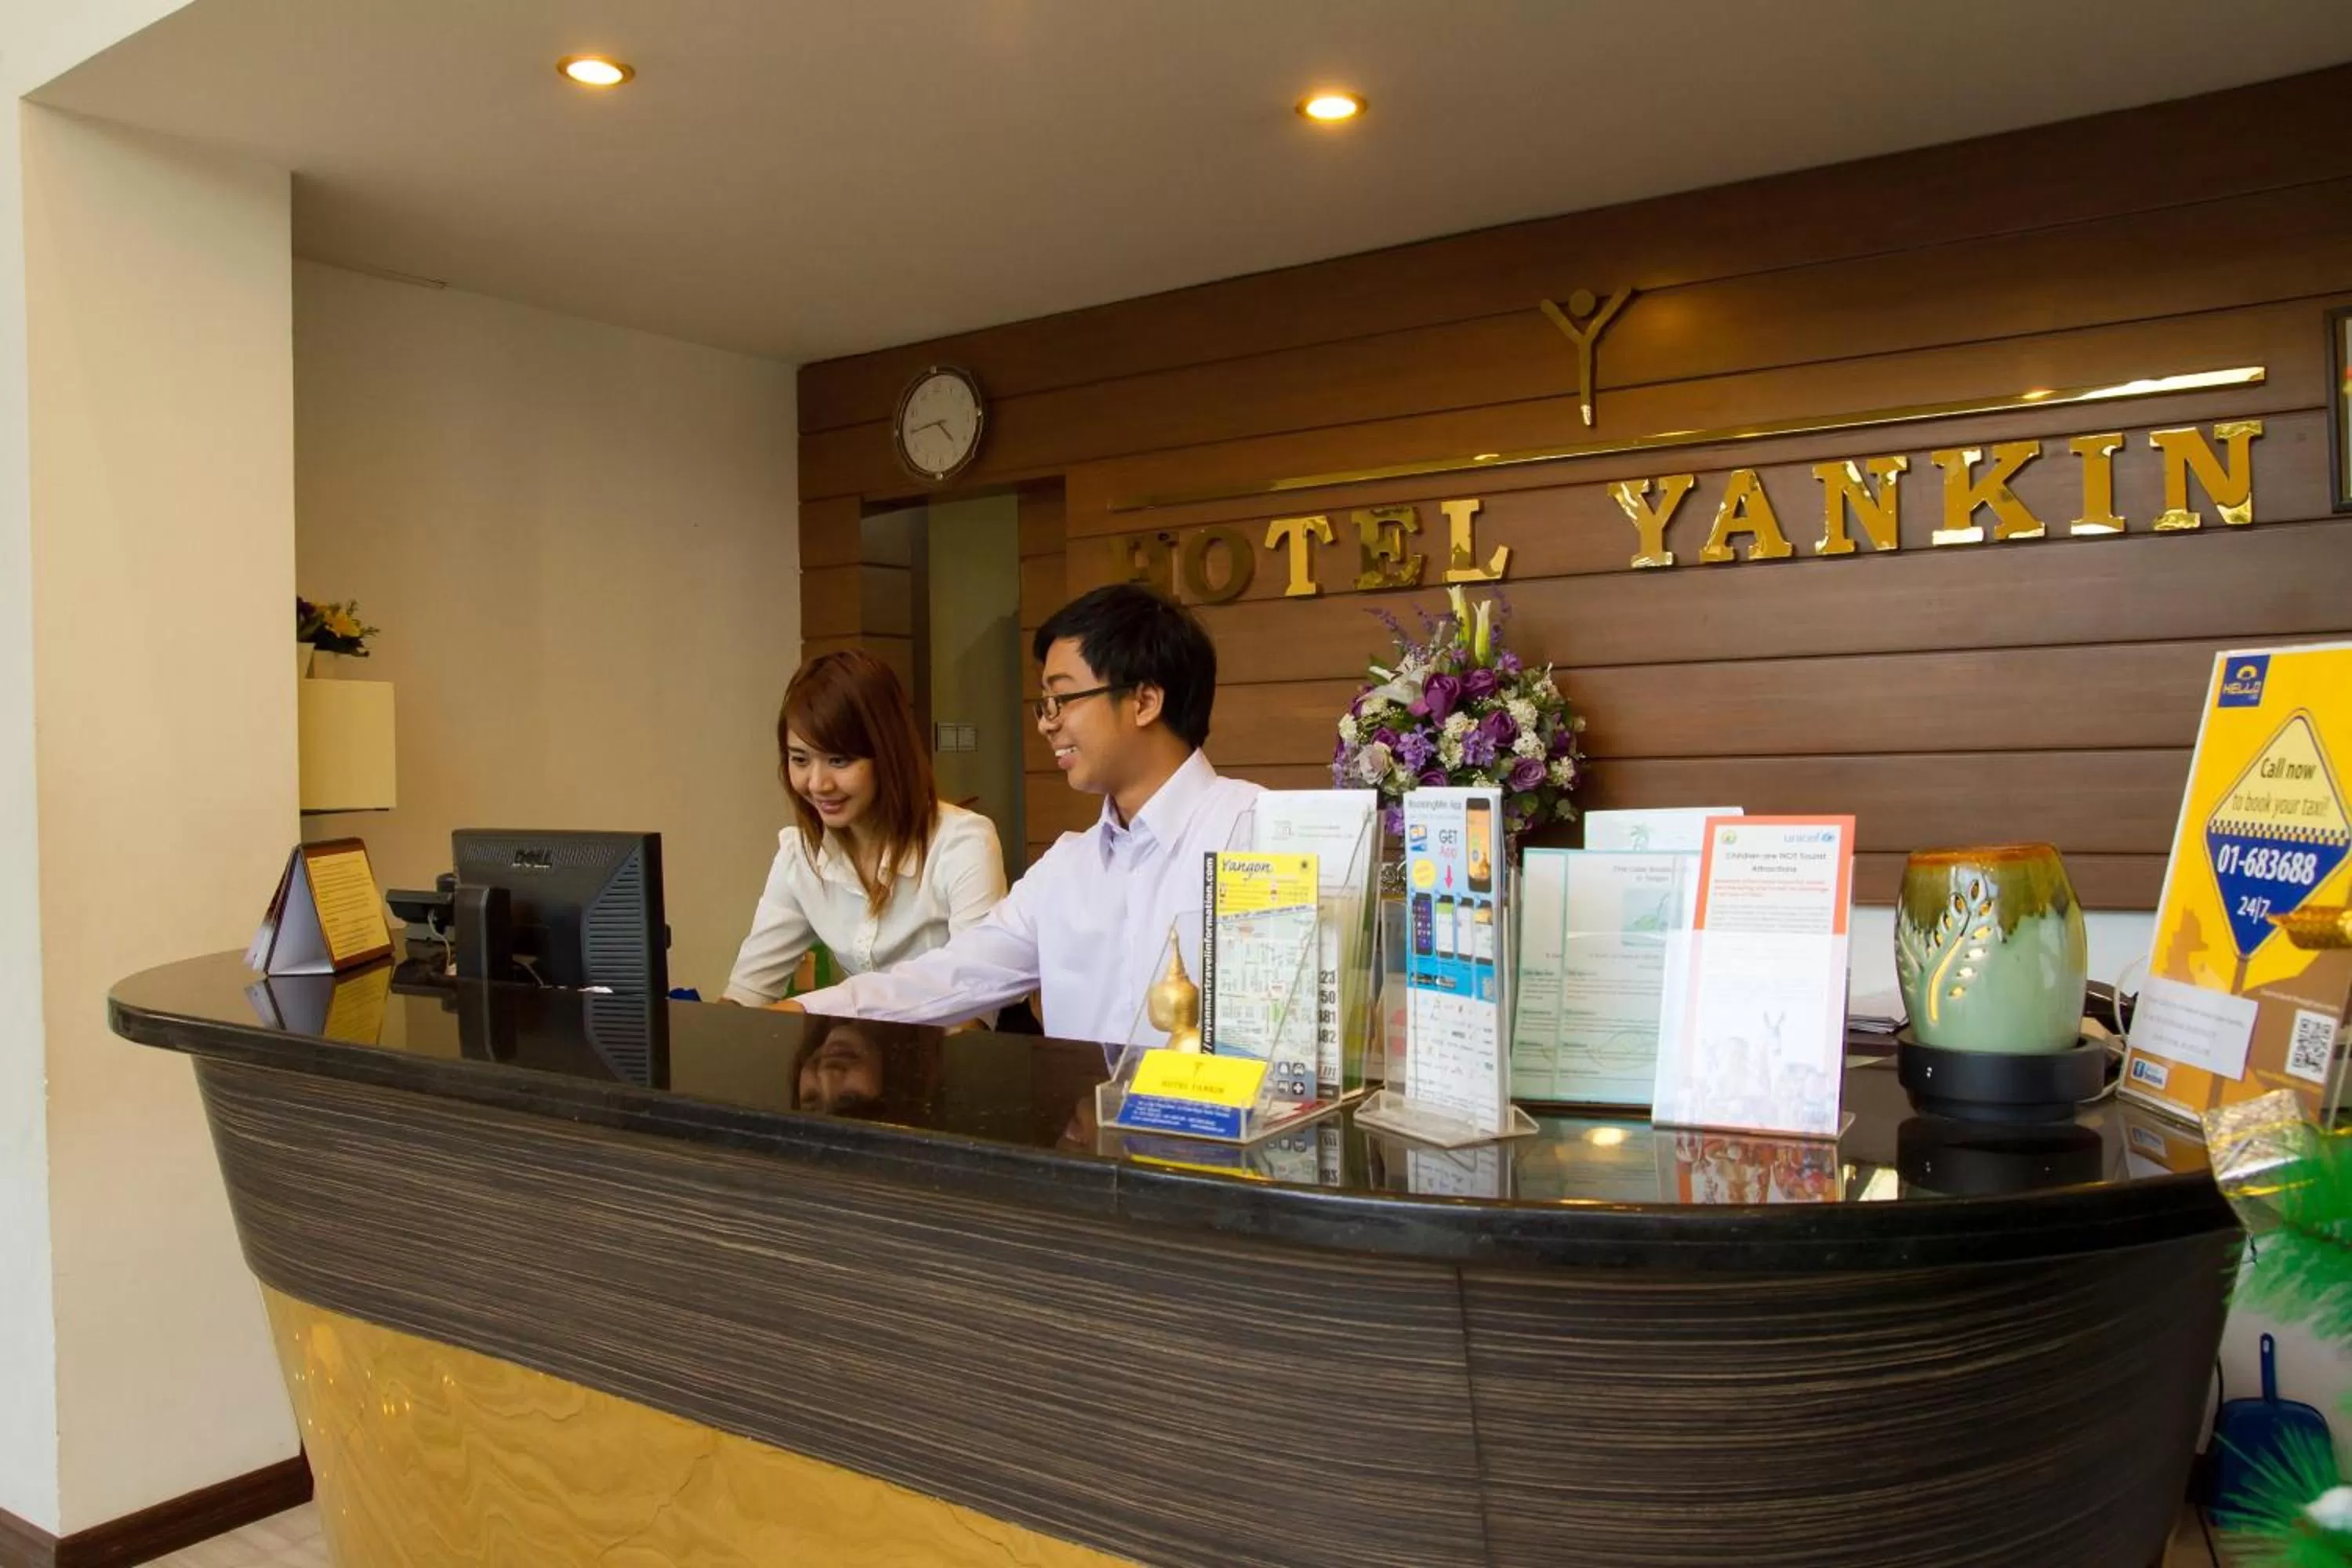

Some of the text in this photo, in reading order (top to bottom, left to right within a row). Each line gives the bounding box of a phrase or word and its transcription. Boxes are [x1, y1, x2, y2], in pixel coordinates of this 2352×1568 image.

[1109, 420, 2263, 605] HOTEL YANKIN
[2222, 680, 2262, 695] HELLO
[2259, 756, 2318, 779] Call now
[2232, 794, 2244, 811] to
[2245, 790, 2271, 813] book
[2271, 797, 2300, 818] your
[1439, 829, 1457, 844] GET
[1784, 832, 1820, 843] unicef
[1221, 858, 1272, 880] Yangon
[2216, 843, 2318, 885] 01-683688
